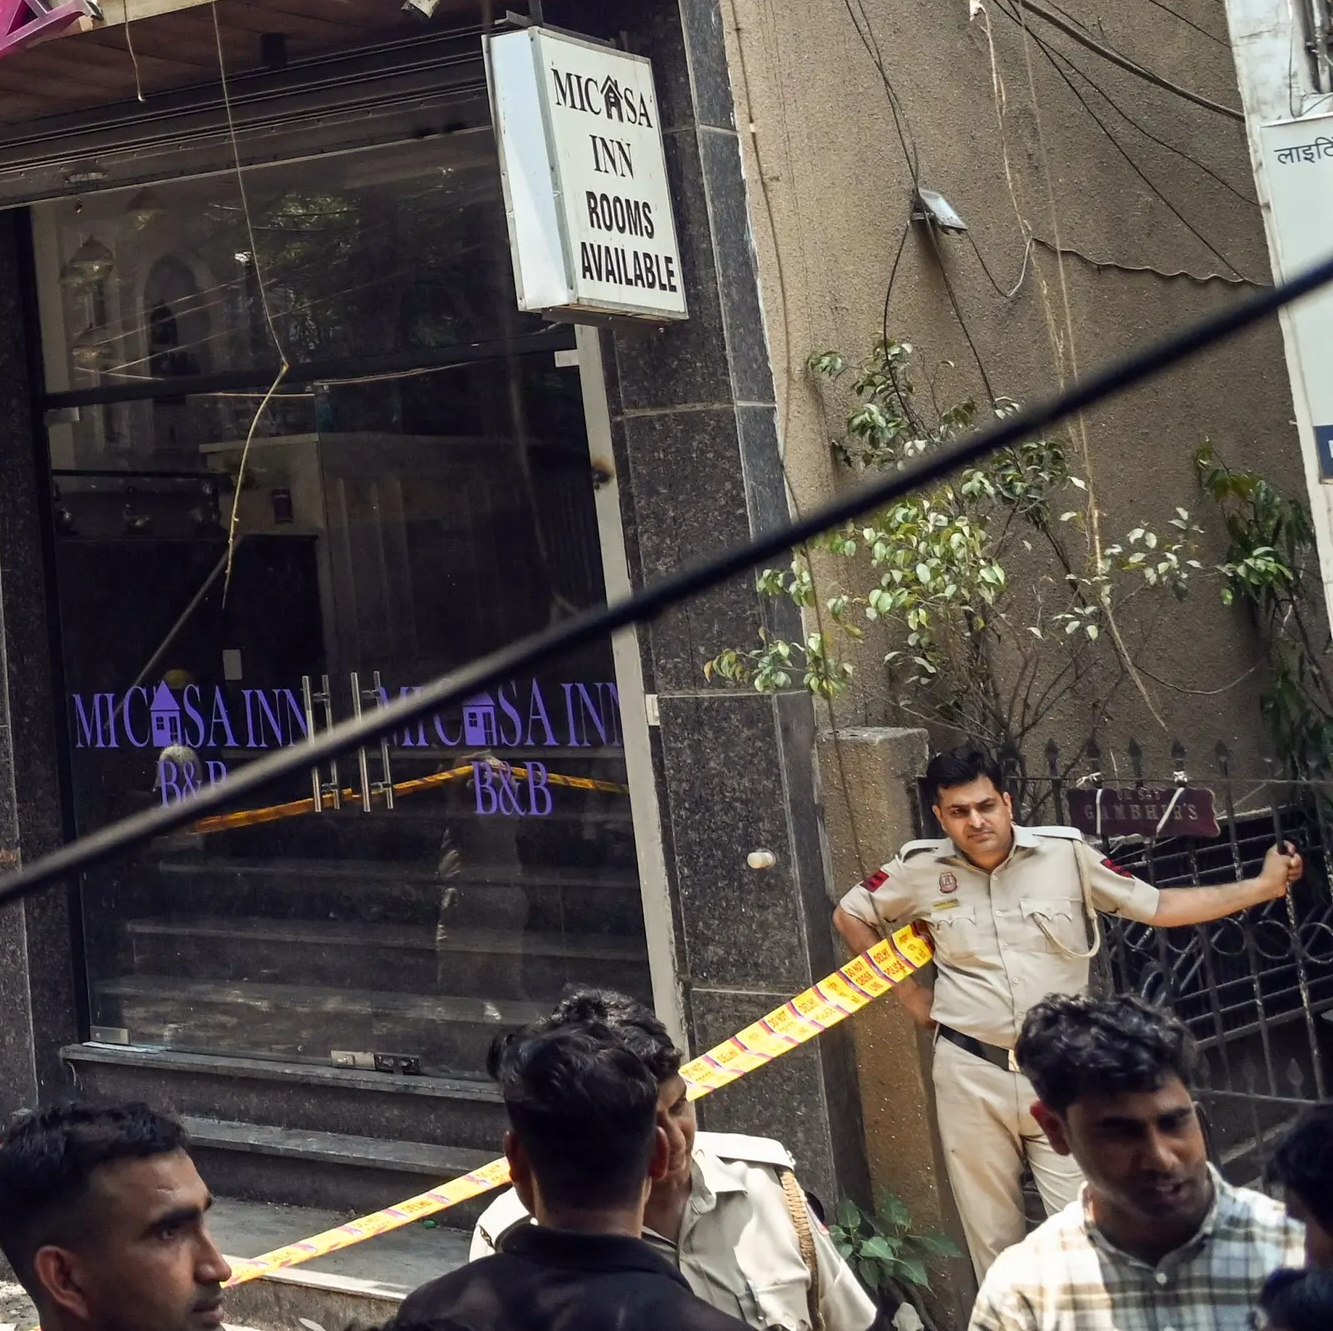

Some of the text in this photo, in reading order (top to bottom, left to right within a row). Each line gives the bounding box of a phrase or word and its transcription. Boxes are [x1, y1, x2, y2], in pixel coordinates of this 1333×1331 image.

[589, 134, 634, 180] INN
[585, 190, 655, 240] ROOMS
[580, 241, 678, 293] AVAILABLE
[469, 760, 554, 817] B&B
[873, 948, 892, 965] DELHI
